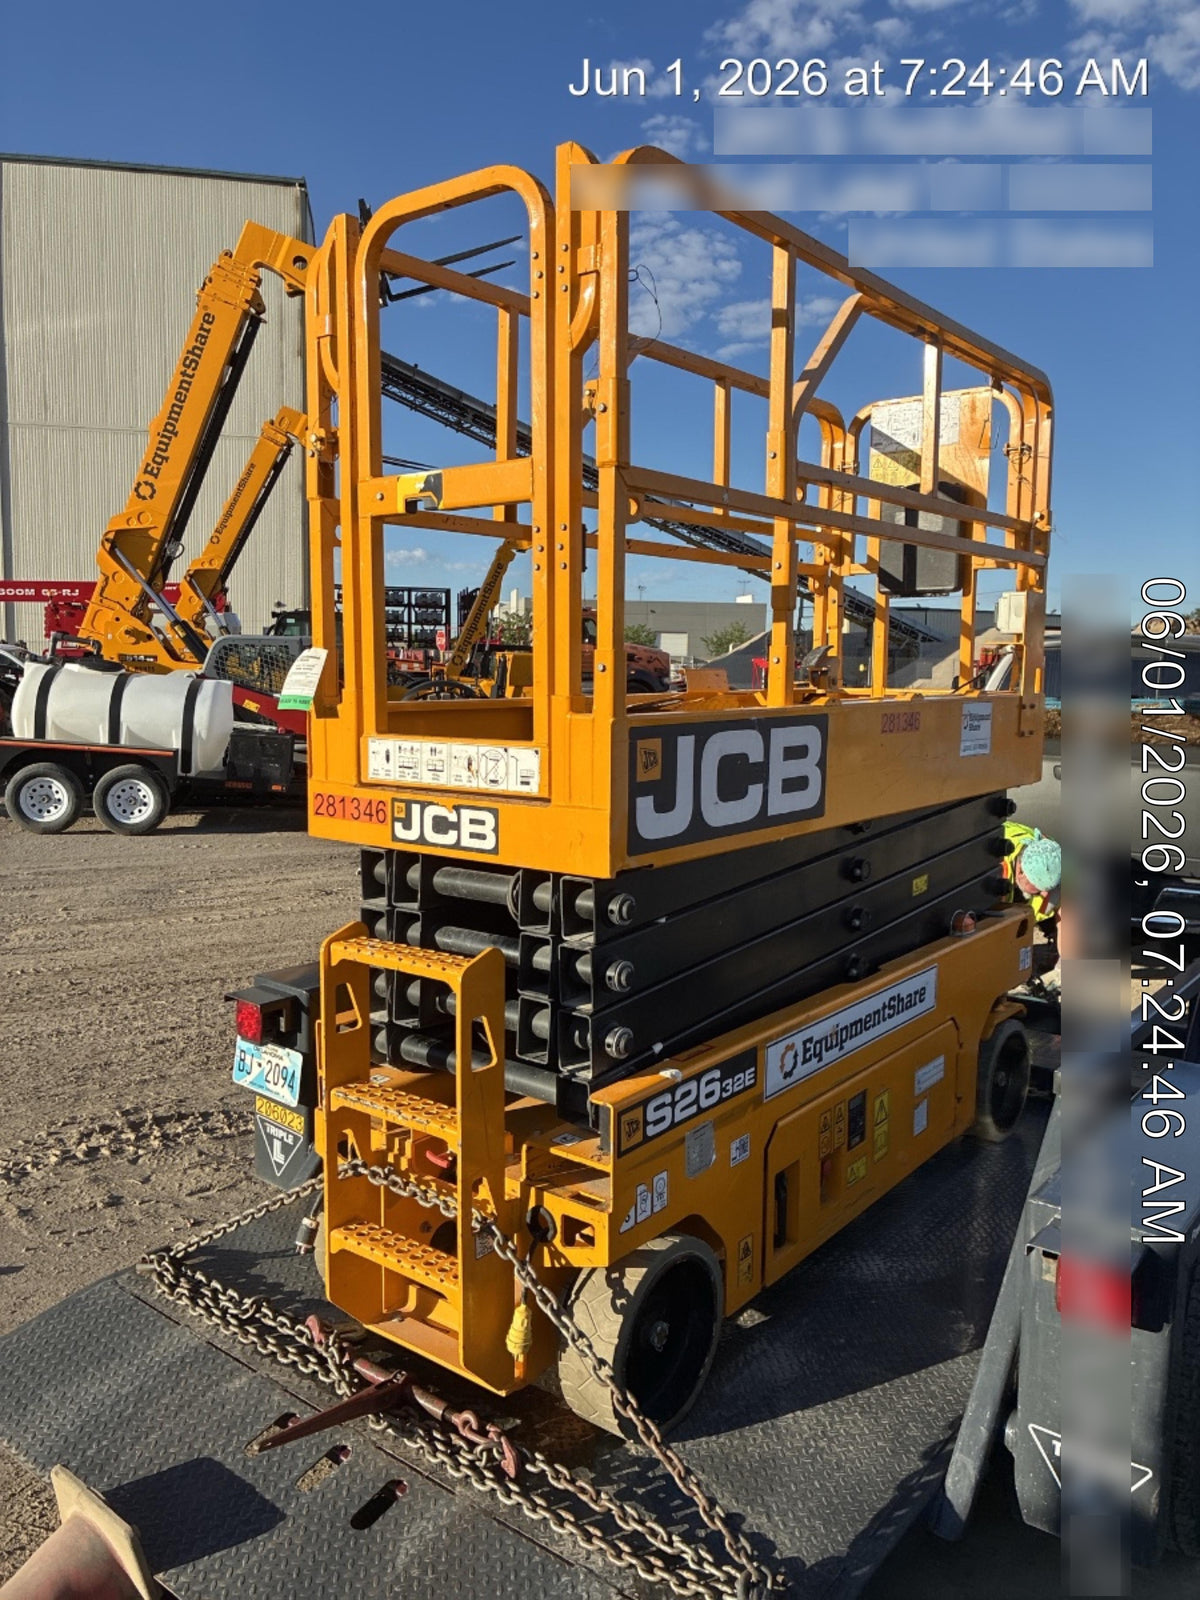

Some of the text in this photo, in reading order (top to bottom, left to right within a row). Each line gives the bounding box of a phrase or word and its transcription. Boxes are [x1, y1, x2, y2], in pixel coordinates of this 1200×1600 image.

[144, 311, 216, 479] EquipmentShare
[214, 462, 257, 535] EquipmentShare
[458, 562, 504, 654] EquipmentShare
[881, 711, 922, 735] 281346
[635, 725, 822, 840] JCB
[314, 792, 387, 825] 281346
[394, 803, 497, 851] JCB
[801, 985, 926, 1065] EquipmentShare
[238, 1049, 254, 1075] BJ
[265, 1060, 296, 1092] 2094
[257, 1097, 304, 1133] 206023
[265, 1122, 295, 1146] TRIPLE
